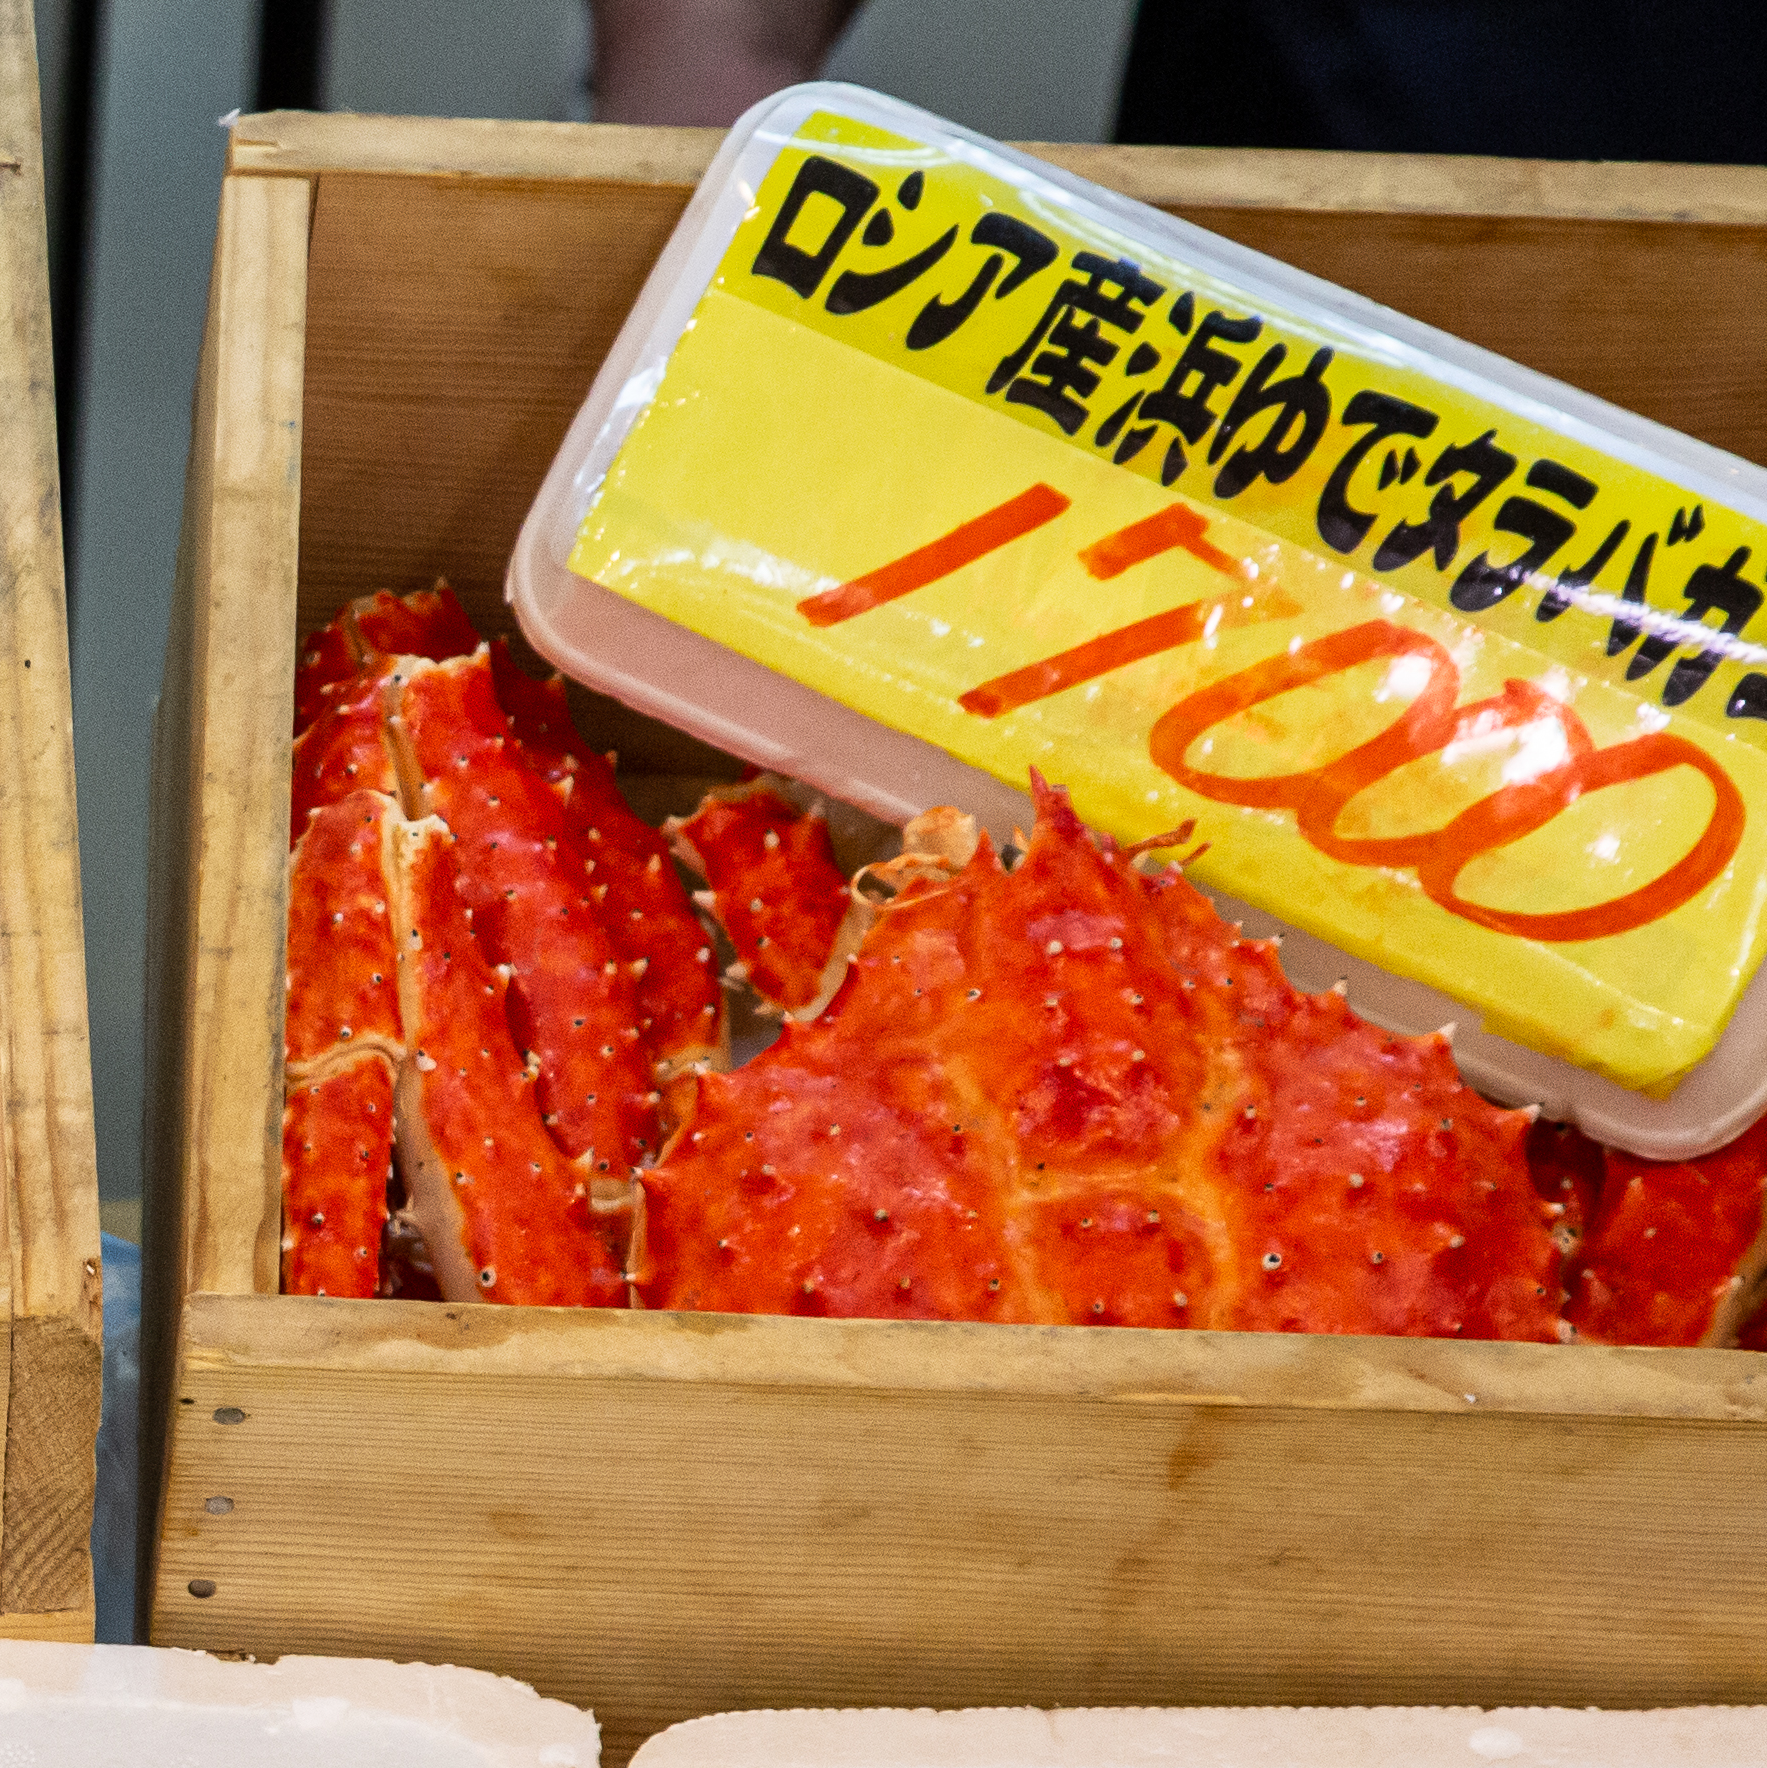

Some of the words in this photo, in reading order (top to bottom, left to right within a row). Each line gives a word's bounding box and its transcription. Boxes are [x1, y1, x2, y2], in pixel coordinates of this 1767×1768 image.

[752, 154, 1767, 720] ロシア産浜ゆでタラバガ
